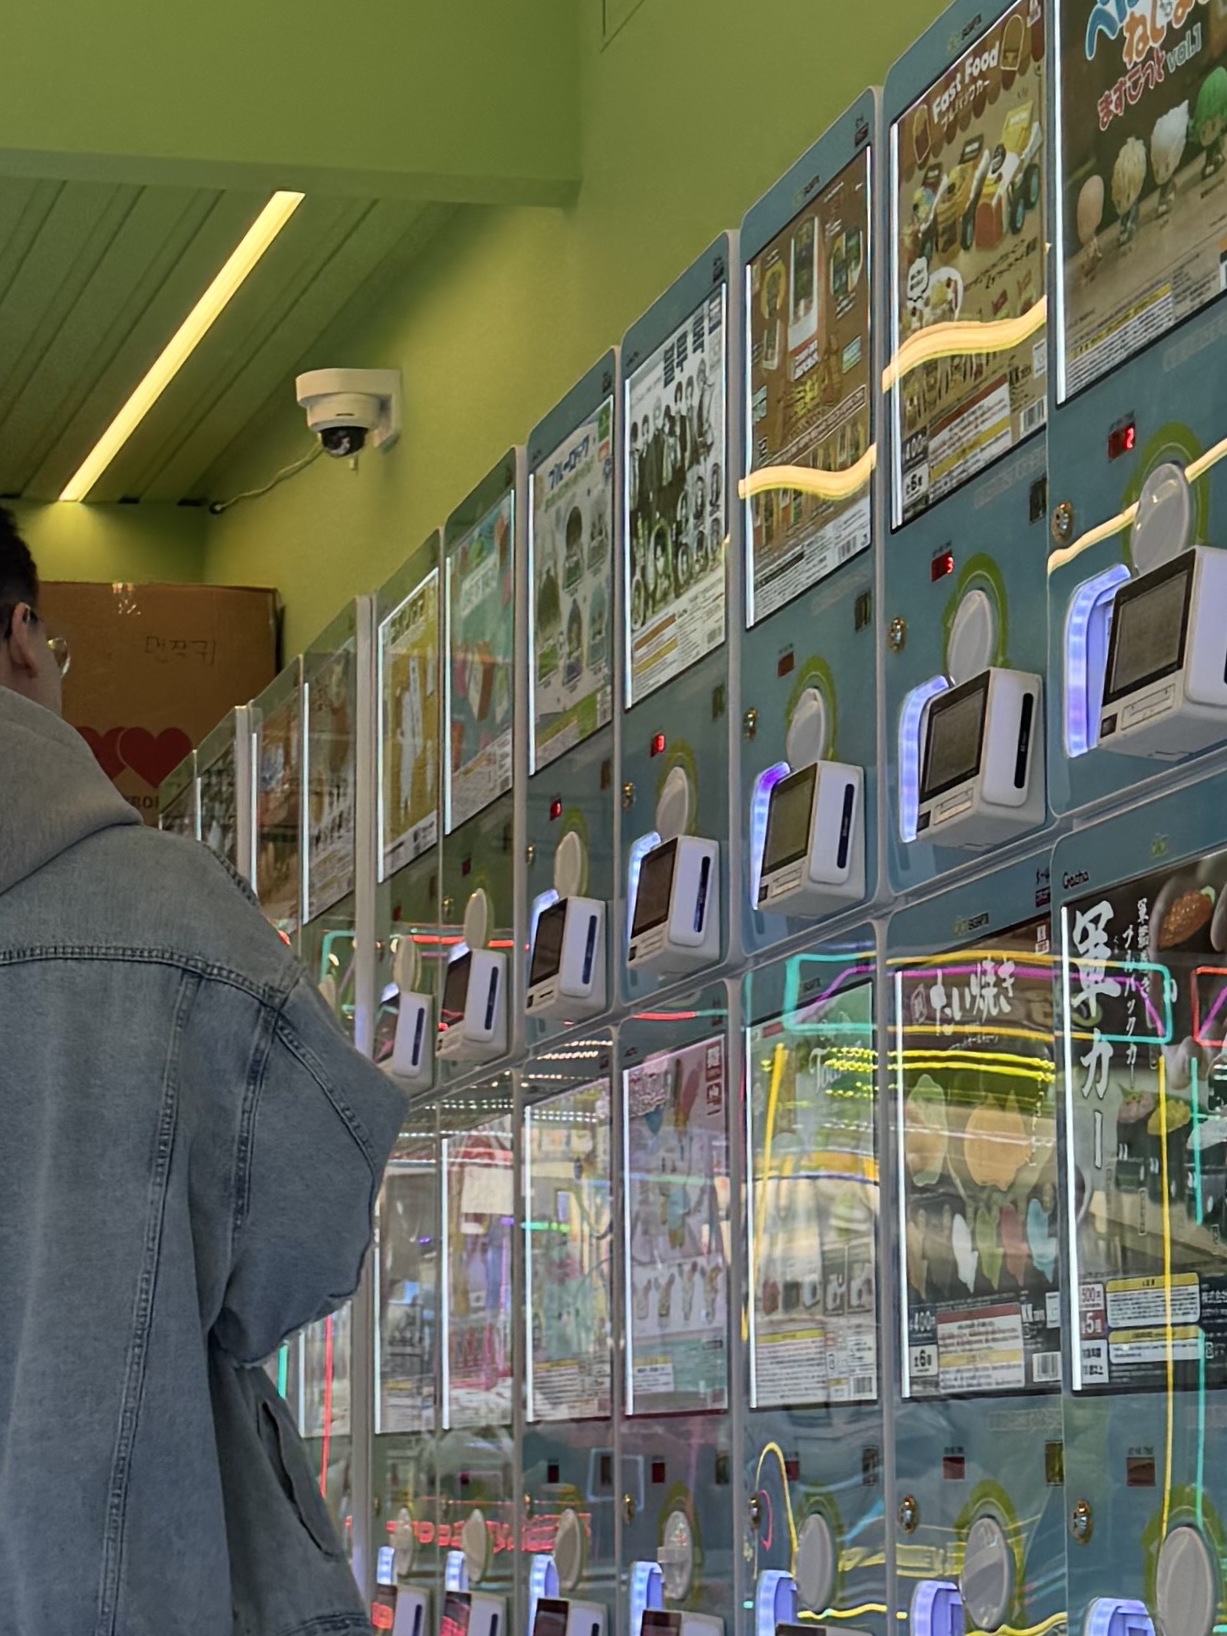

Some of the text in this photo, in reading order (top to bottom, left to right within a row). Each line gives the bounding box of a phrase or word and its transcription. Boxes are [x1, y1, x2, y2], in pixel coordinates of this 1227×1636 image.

[932, 72, 962, 124] Fast
[964, 40, 1001, 84] Food
[1097, 46, 1166, 132] ますこっと
